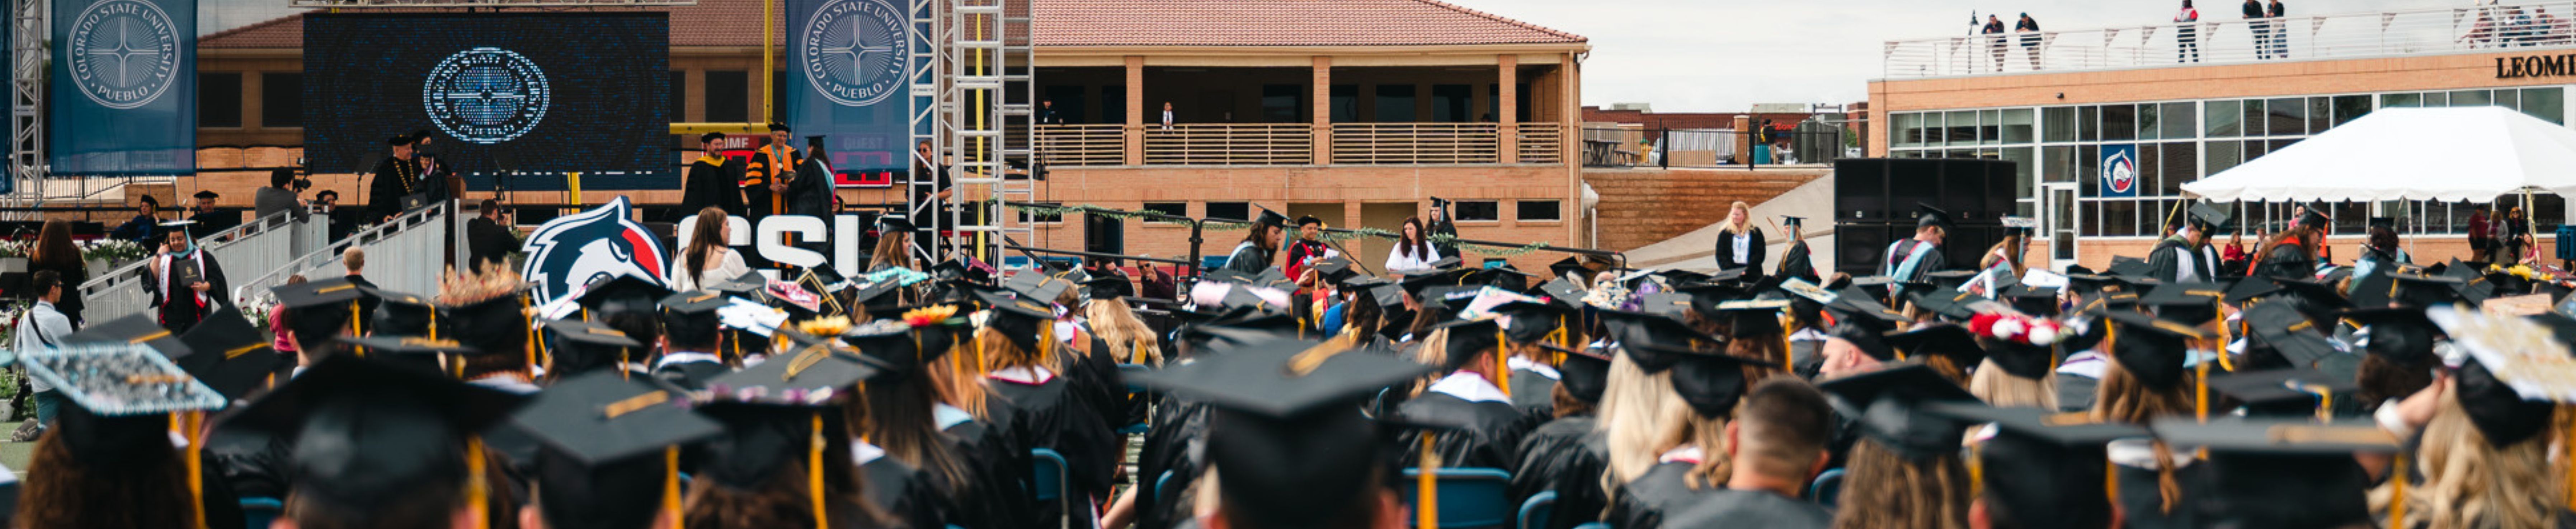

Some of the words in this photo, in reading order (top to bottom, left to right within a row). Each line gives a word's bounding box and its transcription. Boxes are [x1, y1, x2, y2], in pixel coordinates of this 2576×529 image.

[75, 13, 99, 81] COLORADO
[100, 3, 140, 18] STATE
[142, 9, 172, 81] UNIVERSITY
[809, 12, 833, 79] COLORADO
[833, 1, 873, 17] STATE
[874, 6, 905, 78] UNIVERSITY
[98, 85, 148, 101] PUEBLO
[832, 82, 882, 99] PUEBLO
